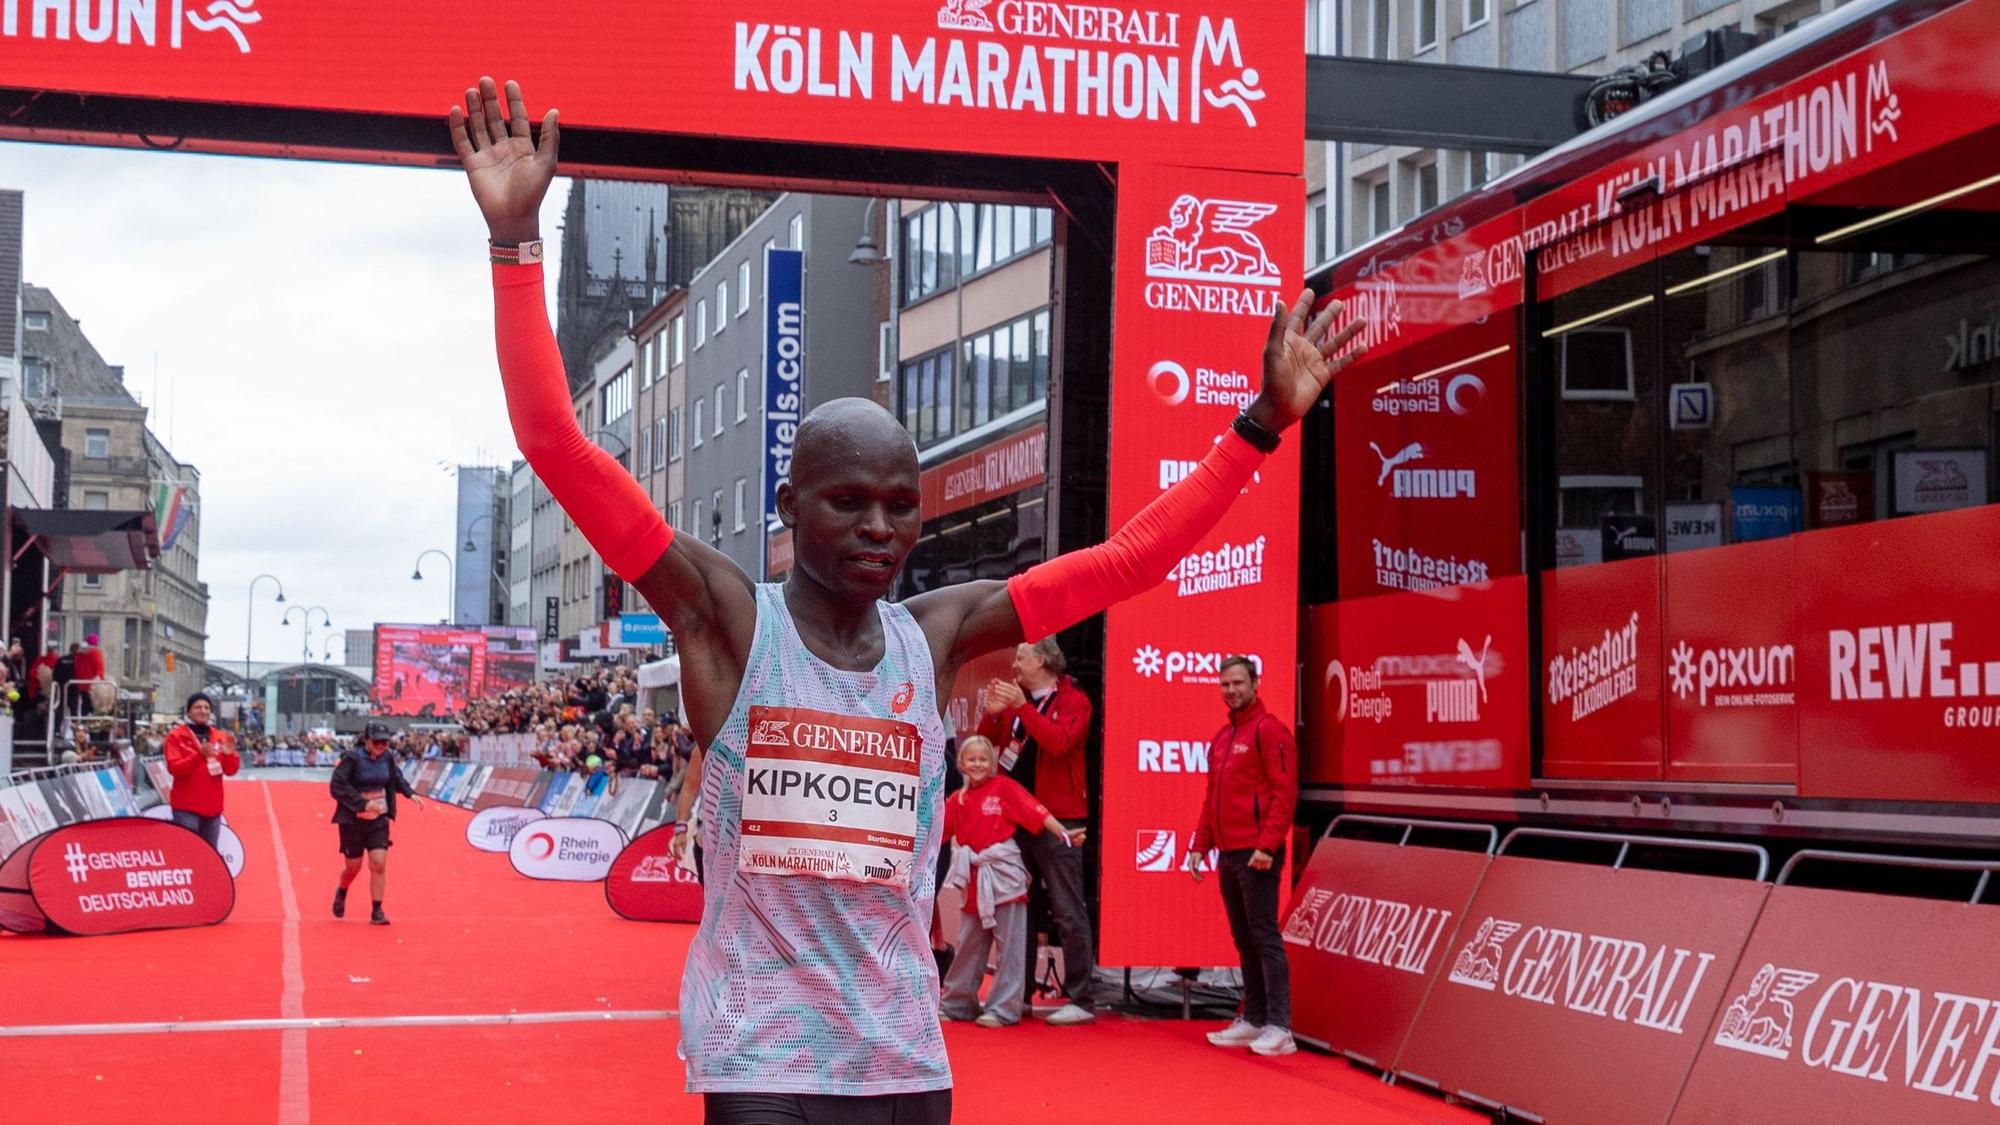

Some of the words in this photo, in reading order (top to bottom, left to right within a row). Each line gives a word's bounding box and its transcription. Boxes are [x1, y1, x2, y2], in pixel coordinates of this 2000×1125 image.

[998, 0, 1180, 48] GENERALI
[735, 22, 874, 100] KÖLN
[892, 34, 1179, 122] MARATHON
[1486, 203, 1606, 288] GENERALI
[1674, 72, 1858, 229] MARATHON
[1145, 281, 1281, 317] GENERALI
[1195, 368, 1248, 389] Rhein
[1195, 386, 1262, 413] Energi
[1177, 566, 1262, 597] ALKOHOLFREI
[1549, 611, 1639, 705] Reissdorf
[1350, 666, 1382, 690] Rhein
[1700, 644, 1795, 707] pixum
[1350, 693, 1392, 723] Energie
[1426, 679, 1479, 722] PUMA
[1571, 664, 1637, 722] ALKOHOLFREI
[793, 722, 917, 763] GENERALI
[1137, 739, 1212, 773] REW
[748, 768, 916, 812] KIPKOECH
[828, 809, 838, 822] 3
[558, 850, 610, 865] Energie
[560, 836, 600, 849] Rhein
[800, 847, 835, 858] GENERALI
[126, 869, 193, 888] BEWEGT
[752, 853, 776, 869] KÖLN
[778, 856, 835, 873] MARATHON
[864, 865, 892, 880] PUMA
[78, 889, 194, 912] DEUTSCHLAND
[1313, 893, 1452, 975] GENERALI
[1502, 925, 1716, 1035] GENERALI
